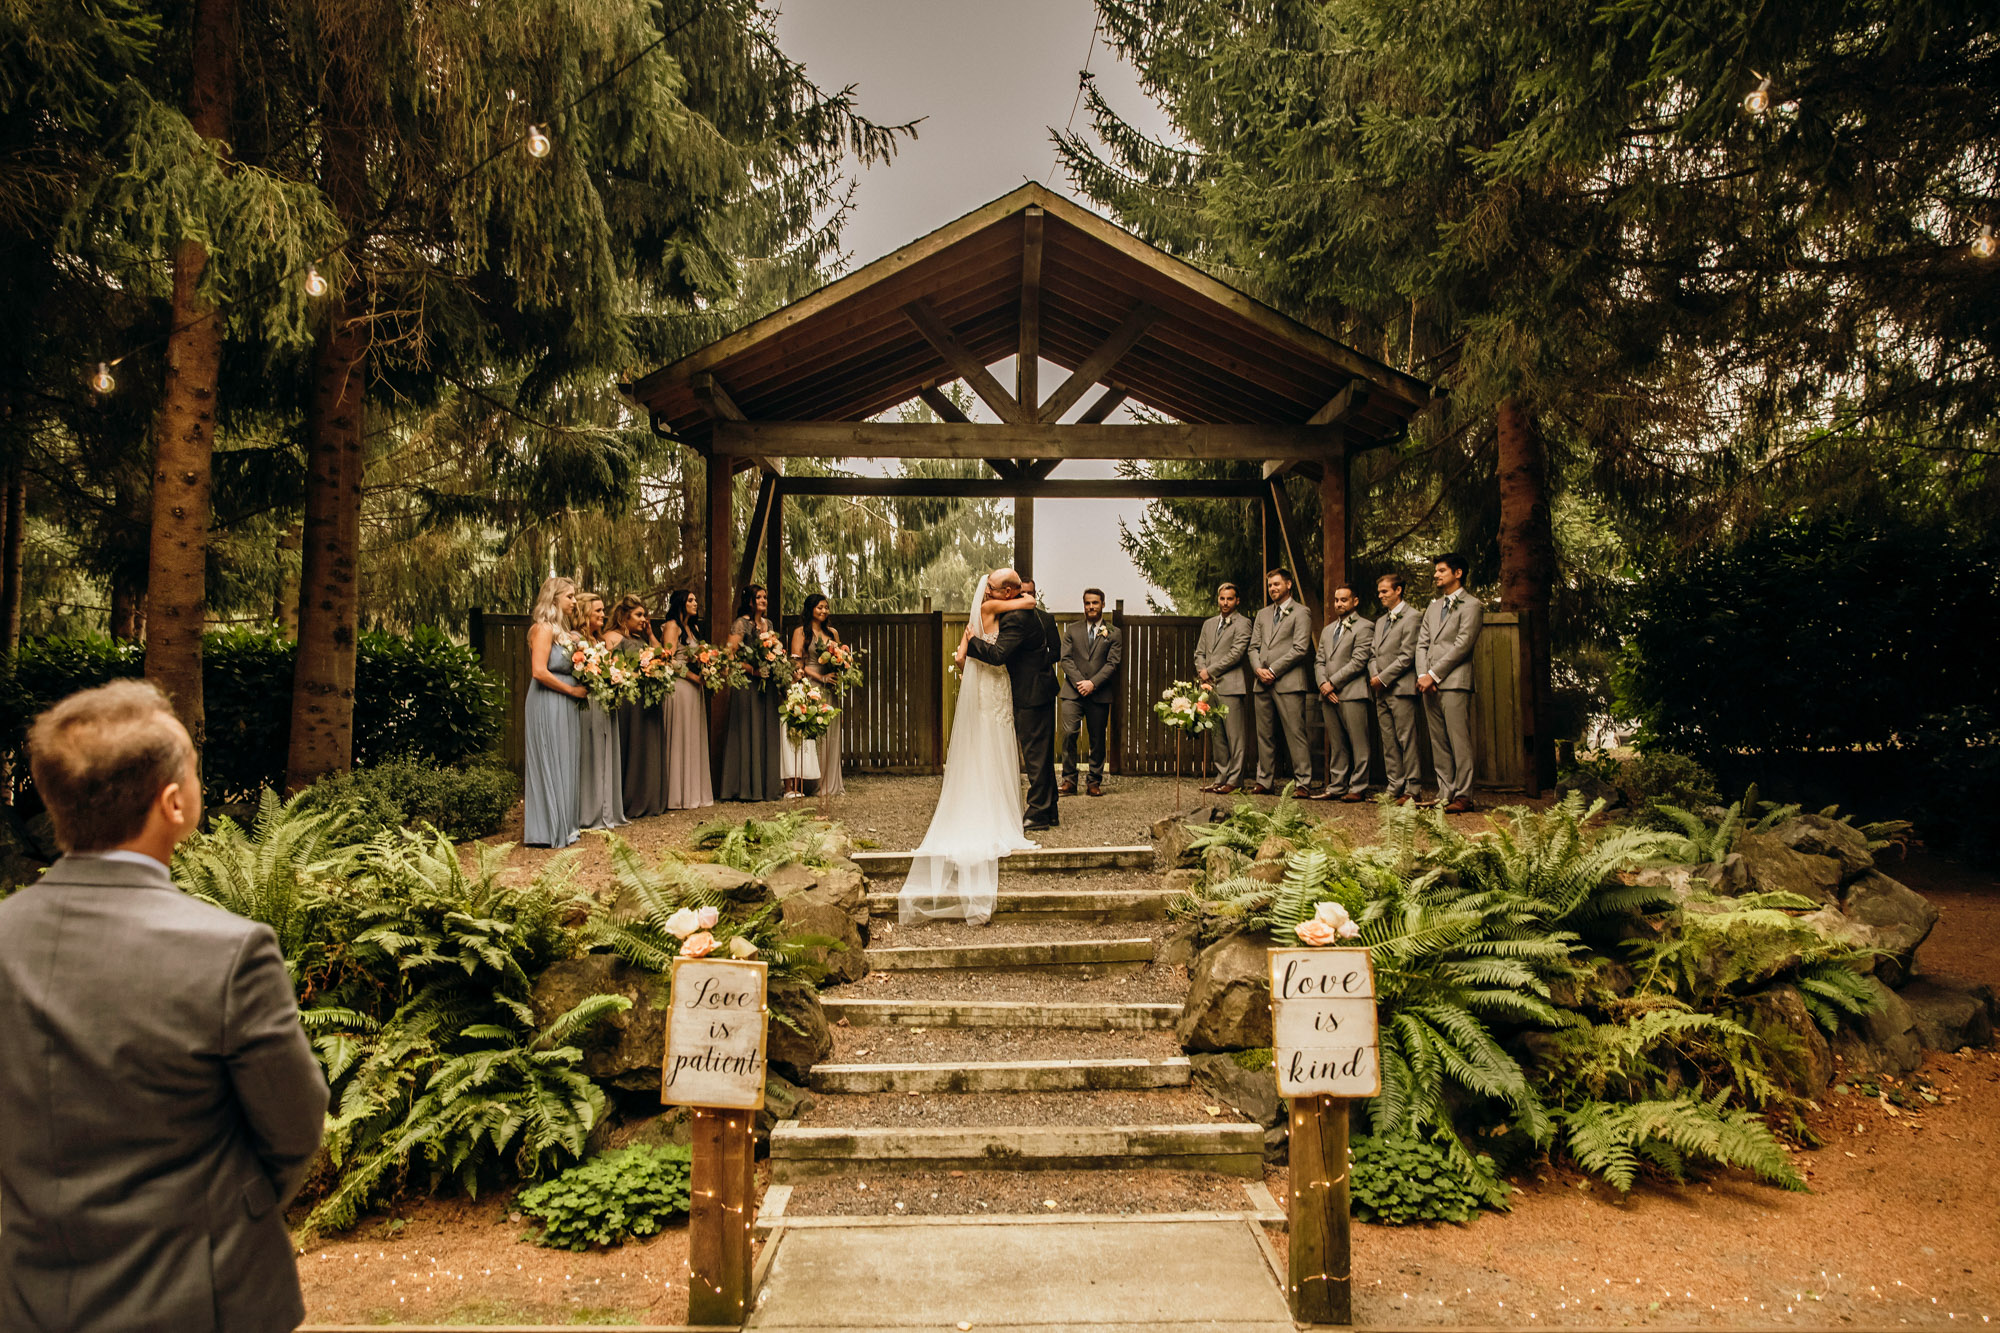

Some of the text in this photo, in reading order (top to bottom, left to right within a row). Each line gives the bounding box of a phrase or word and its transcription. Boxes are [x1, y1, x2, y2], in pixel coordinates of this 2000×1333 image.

[685, 977, 753, 1010] Love
[1283, 960, 1366, 999] love
[709, 1021, 733, 1039] is
[1315, 1012, 1344, 1032] is
[665, 1046, 759, 1087] patient
[1289, 1047, 1366, 1083] kind
